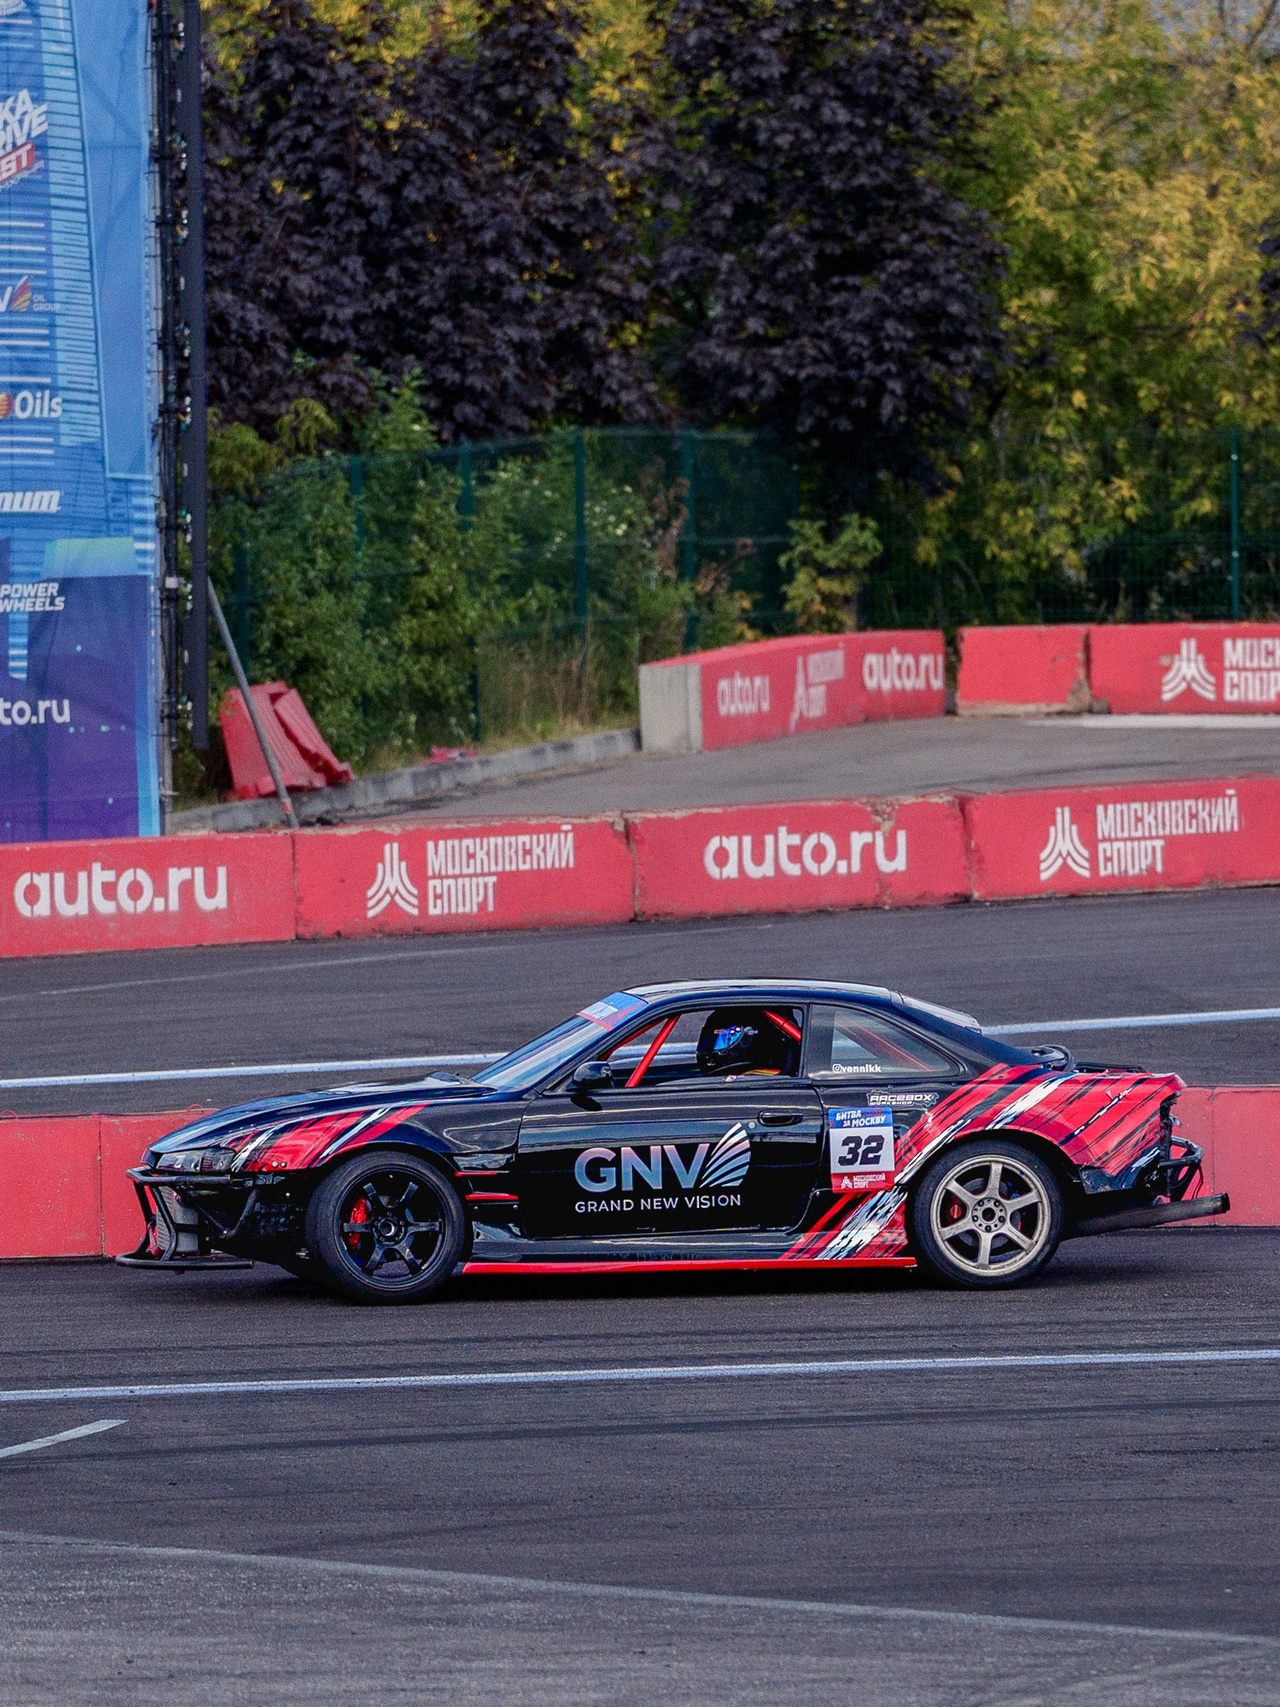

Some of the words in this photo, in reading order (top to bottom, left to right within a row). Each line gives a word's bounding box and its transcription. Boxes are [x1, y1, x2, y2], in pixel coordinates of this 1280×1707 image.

[0, 88, 34, 124] KA
[0, 103, 48, 154] IVE
[0, 143, 32, 181] ST
[14, 389, 63, 419] Oils
[1, 583, 59, 598] POWER
[862, 647, 944, 693] auto.ru
[0, 698, 71, 725] to.ru
[716, 671, 771, 717] auto.ru
[1096, 789, 1239, 839] МОСКОВСКИЙ
[427, 824, 575, 877] МОСКОВСКИЙ
[704, 826, 907, 881] auto.ru
[1098, 839, 1165, 878] СПОРТ
[14, 862, 228, 918] auto.ru
[427, 876, 498, 916] СПОРТ
[836, 1110, 862, 1121] БИТВА
[851, 1115, 886, 1127] МОСКВУ
[574, 1143, 711, 1193] GNV
[837, 1135, 885, 1167] 32
[575, 1199, 634, 1213] GRAND
[640, 1197, 679, 1210] NEW
[684, 1194, 741, 1209] VISION
